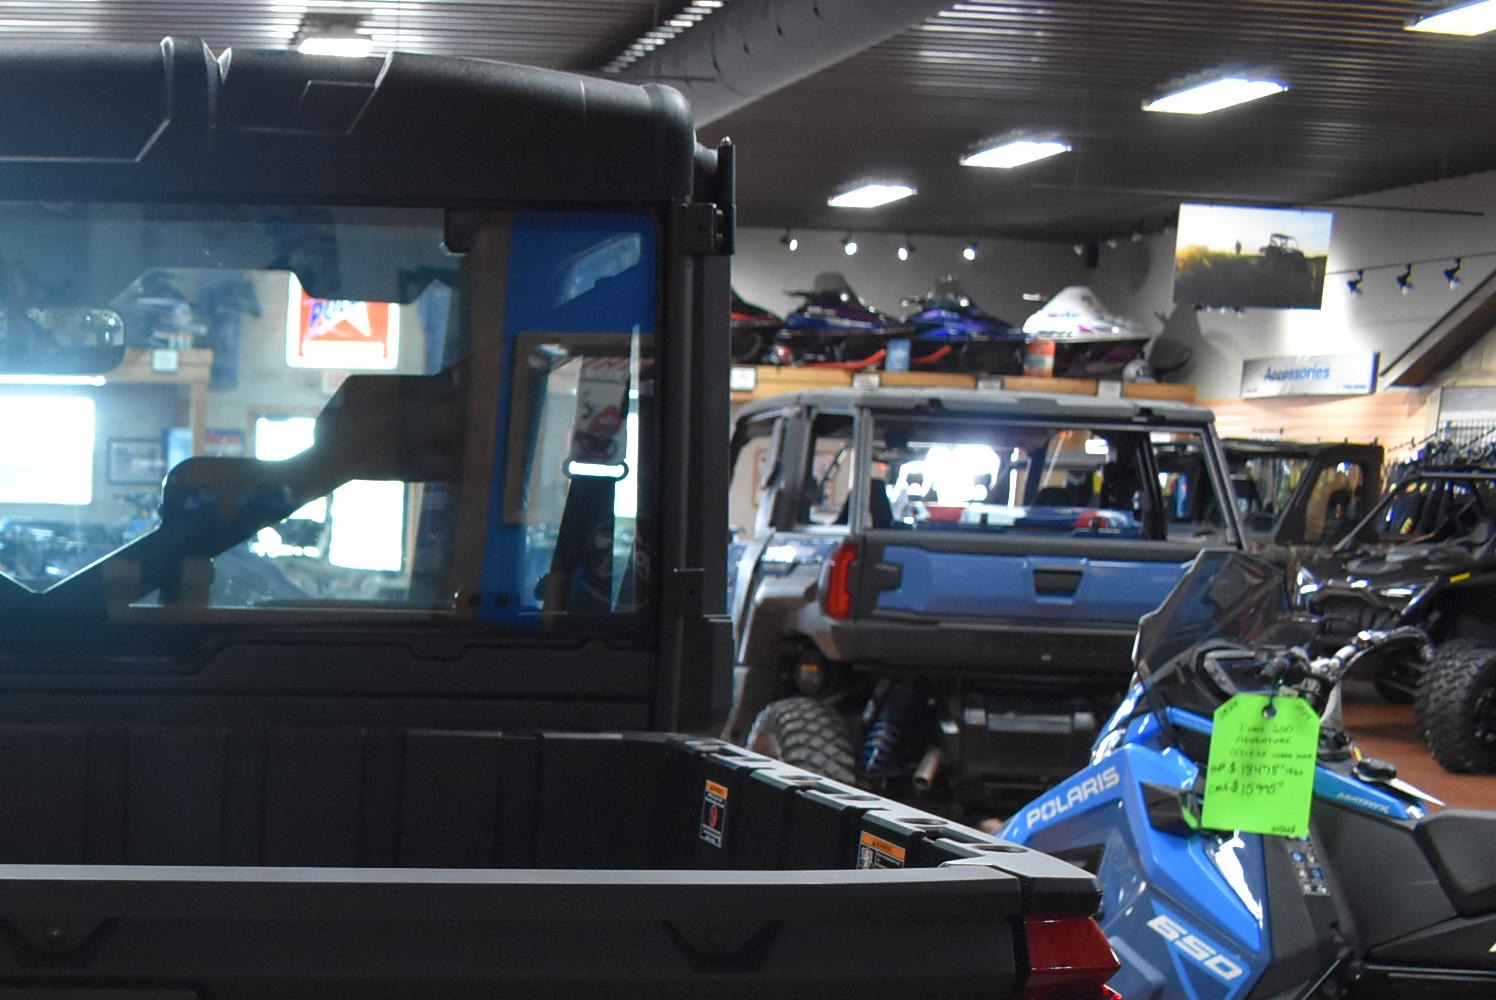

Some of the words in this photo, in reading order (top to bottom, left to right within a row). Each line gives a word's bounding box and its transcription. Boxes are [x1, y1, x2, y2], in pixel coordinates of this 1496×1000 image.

[1264, 363, 1331, 381] Accessories
[1026, 766, 1121, 829] POLARIS
[1147, 915, 1243, 980] 650
